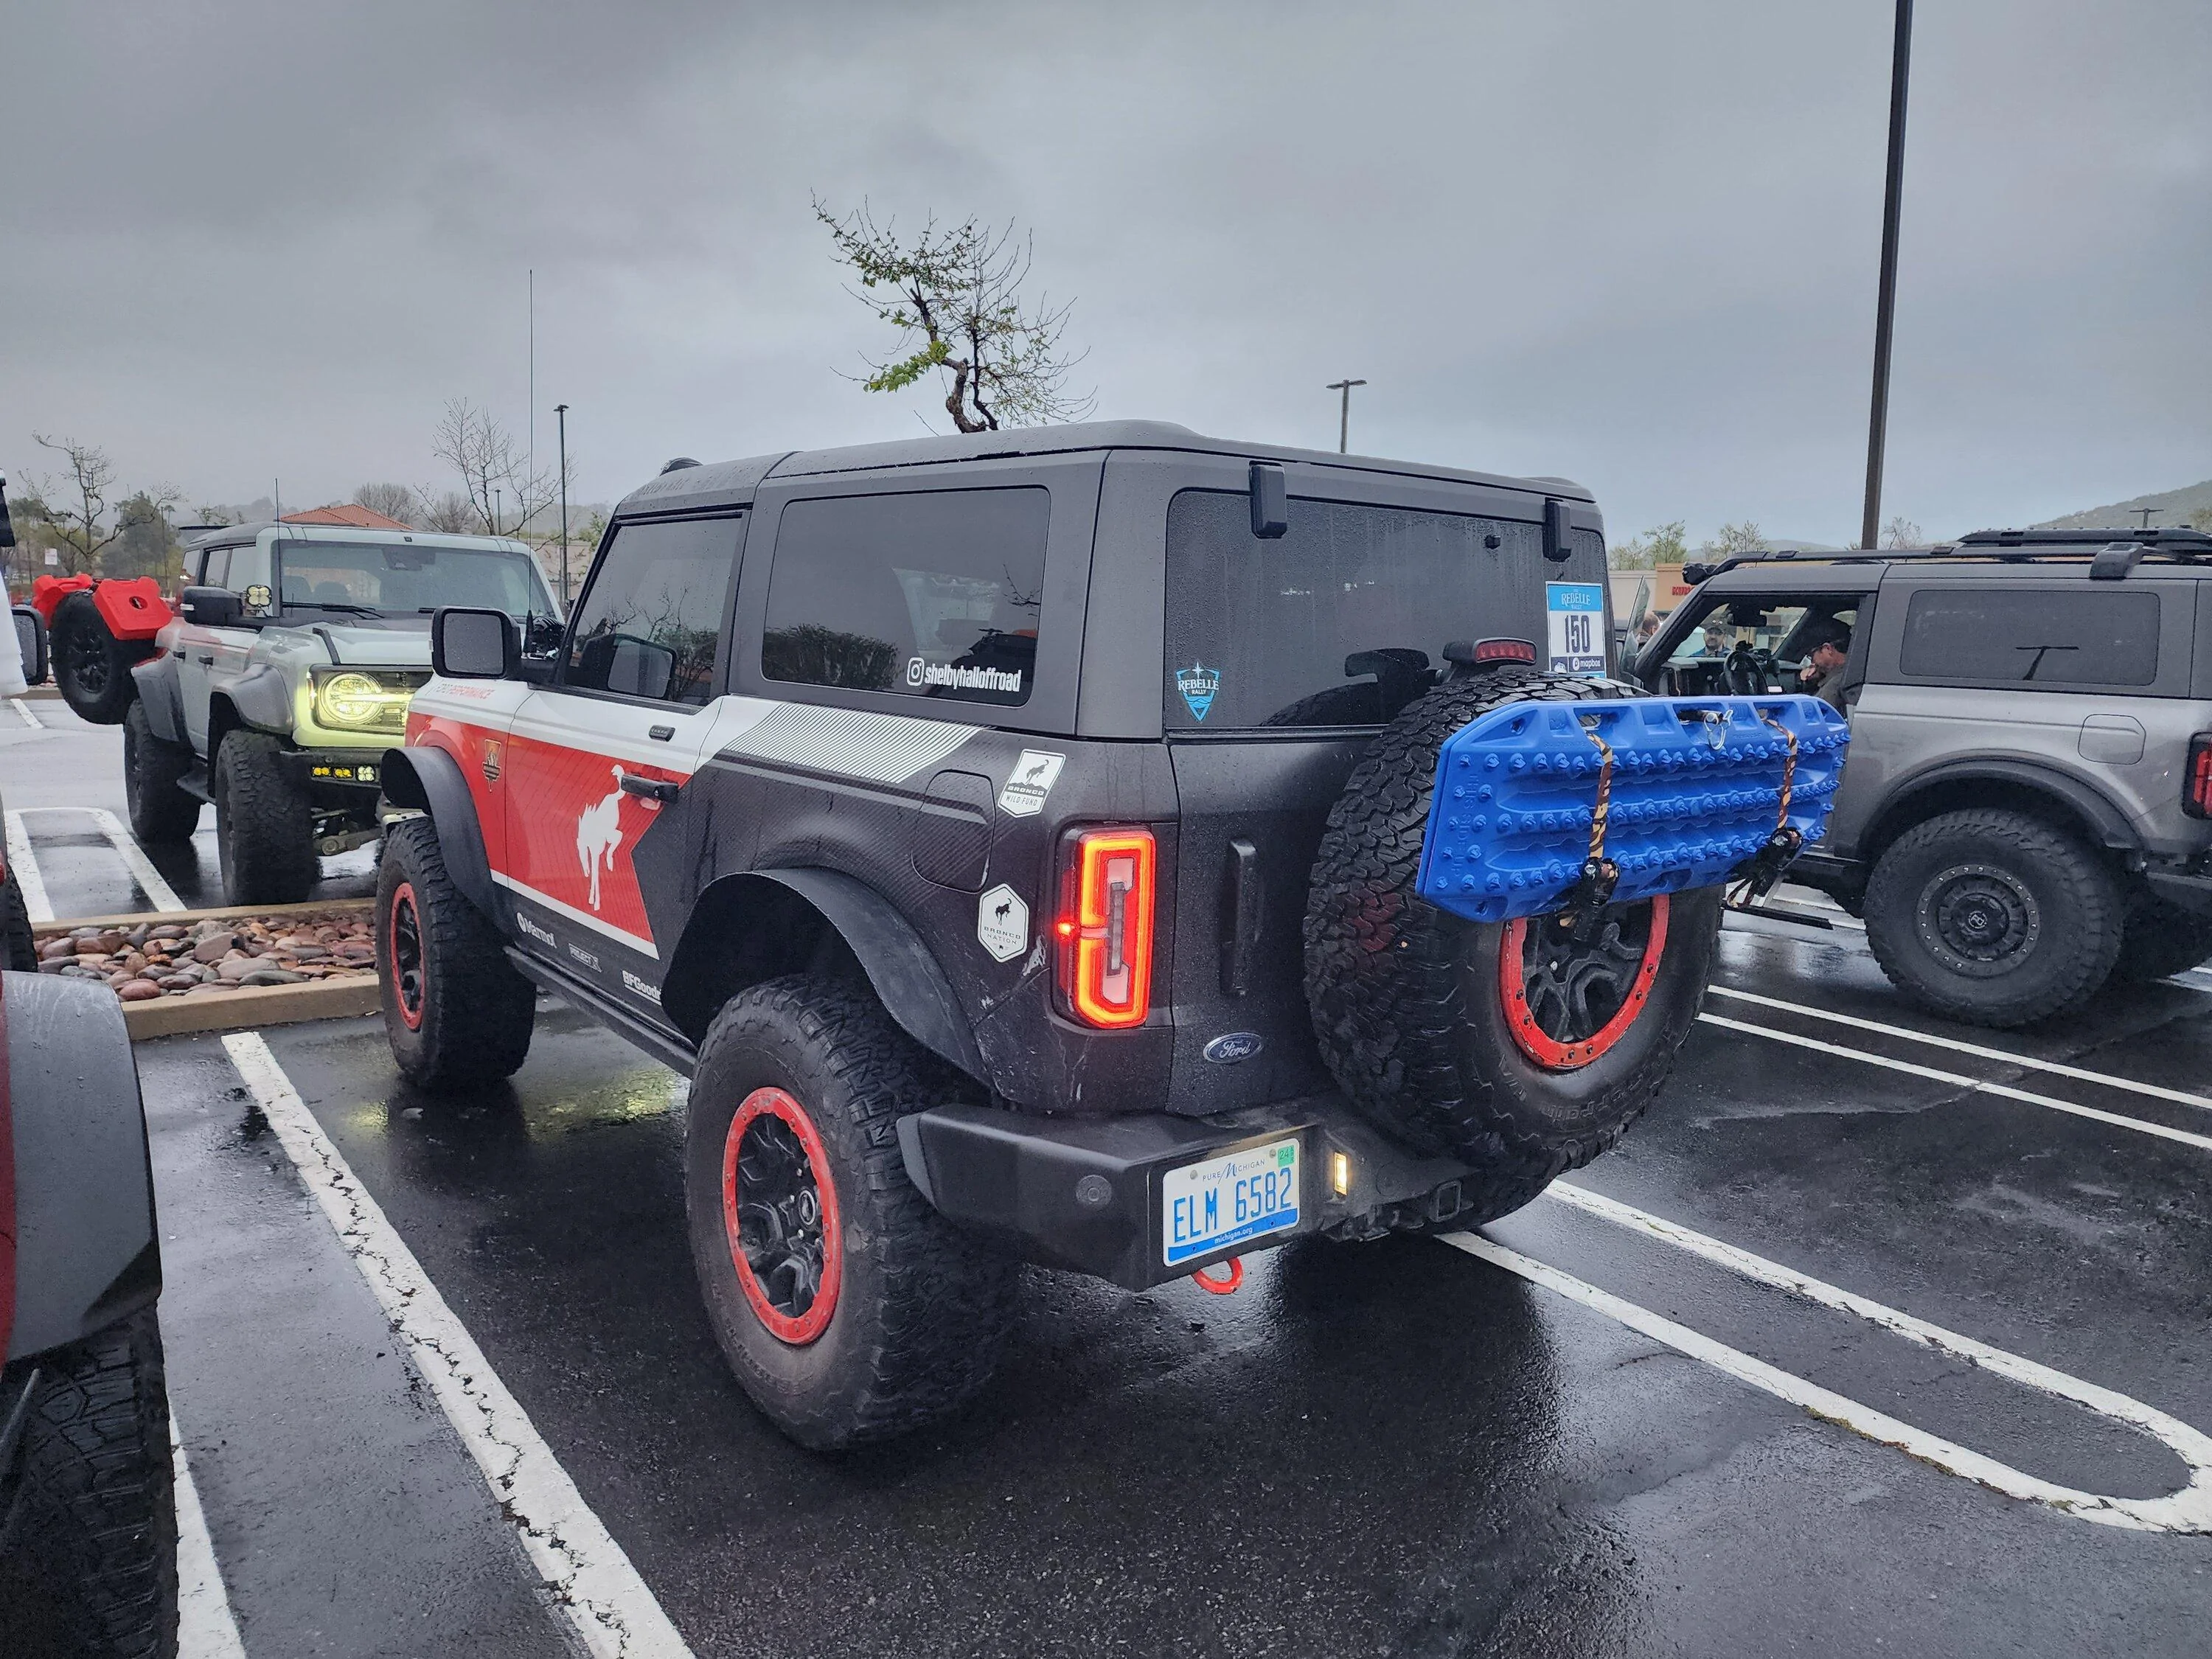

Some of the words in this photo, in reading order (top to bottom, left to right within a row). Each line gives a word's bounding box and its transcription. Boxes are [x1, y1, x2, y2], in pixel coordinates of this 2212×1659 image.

[1561, 592, 1592, 607] REBELLE
[1565, 615, 1590, 653] 150
[1580, 658, 1601, 669] mapbox
[924, 663, 1022, 692] shelbyhalloffroad
[1178, 678, 1220, 692] REBELLE
[1007, 785, 1045, 796] BRONCO
[1005, 795, 1021, 804] WILD
[1021, 797, 1038, 807] FUND
[984, 926, 1021, 939] BRONCO
[987, 933, 1017, 945] NATION
[1219, 1040, 1251, 1059] Ford
[1203, 1171, 1221, 1181] PURE
[1174, 1187, 1217, 1243] ELM
[1235, 1167, 1292, 1222] 6582
[1214, 1227, 1253, 1245] michigan.org
